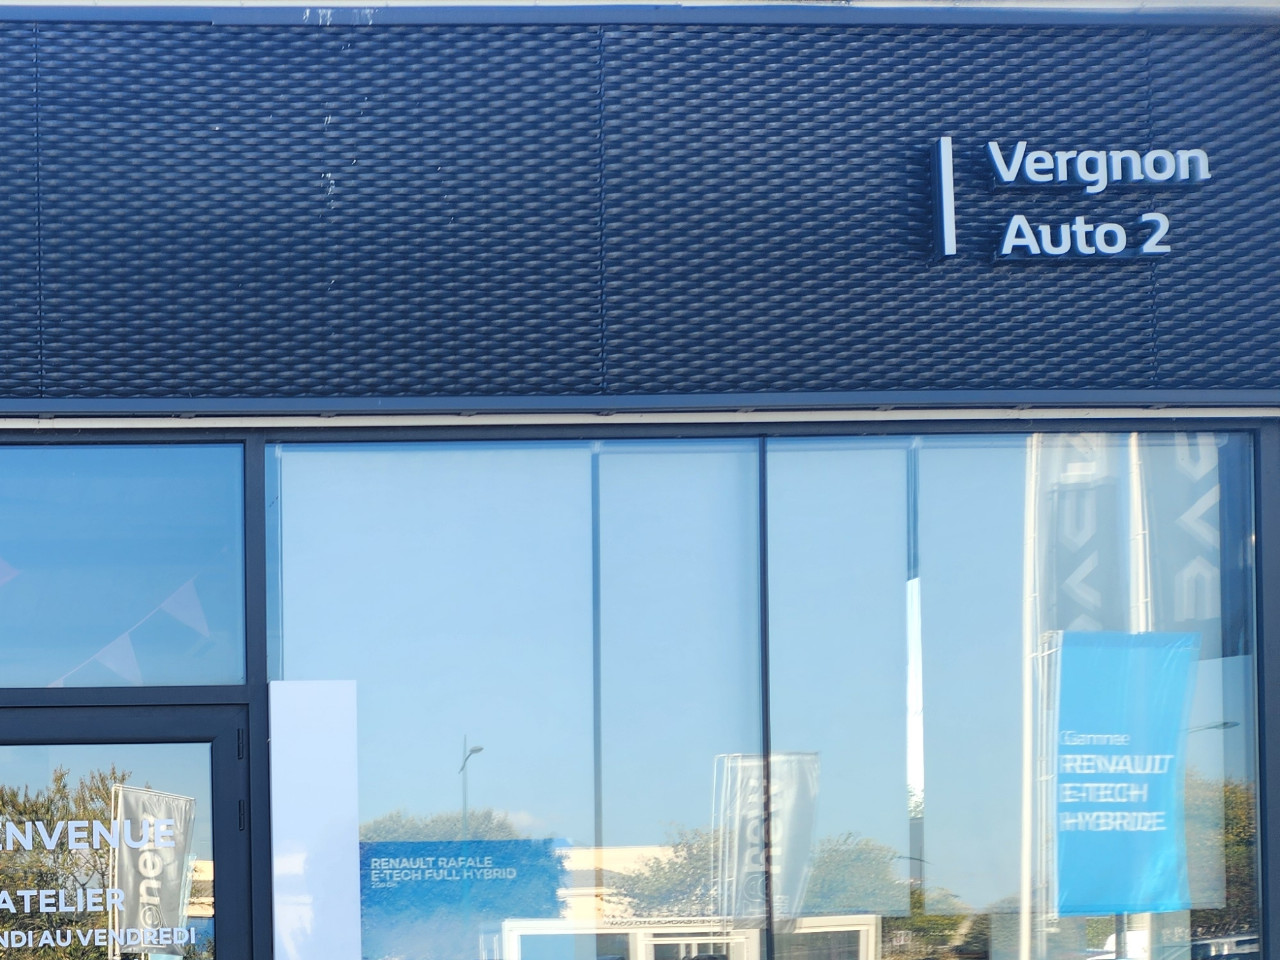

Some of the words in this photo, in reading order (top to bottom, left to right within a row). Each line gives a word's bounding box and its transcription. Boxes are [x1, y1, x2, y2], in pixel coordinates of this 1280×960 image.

[988, 140, 1212, 194] Vergnon
[1001, 214, 1128, 255] Auto
[1140, 212, 1171, 254] 2
[370, 856, 436, 870] RENAULT
[437, 855, 493, 869] RAFALE
[370, 869, 422, 882] E-TECH
[424, 868, 461, 881] FULL
[463, 867, 517, 880] HYBRID
[38, 928, 73, 949] AU
[76, 926, 196, 948] VENDREDI
